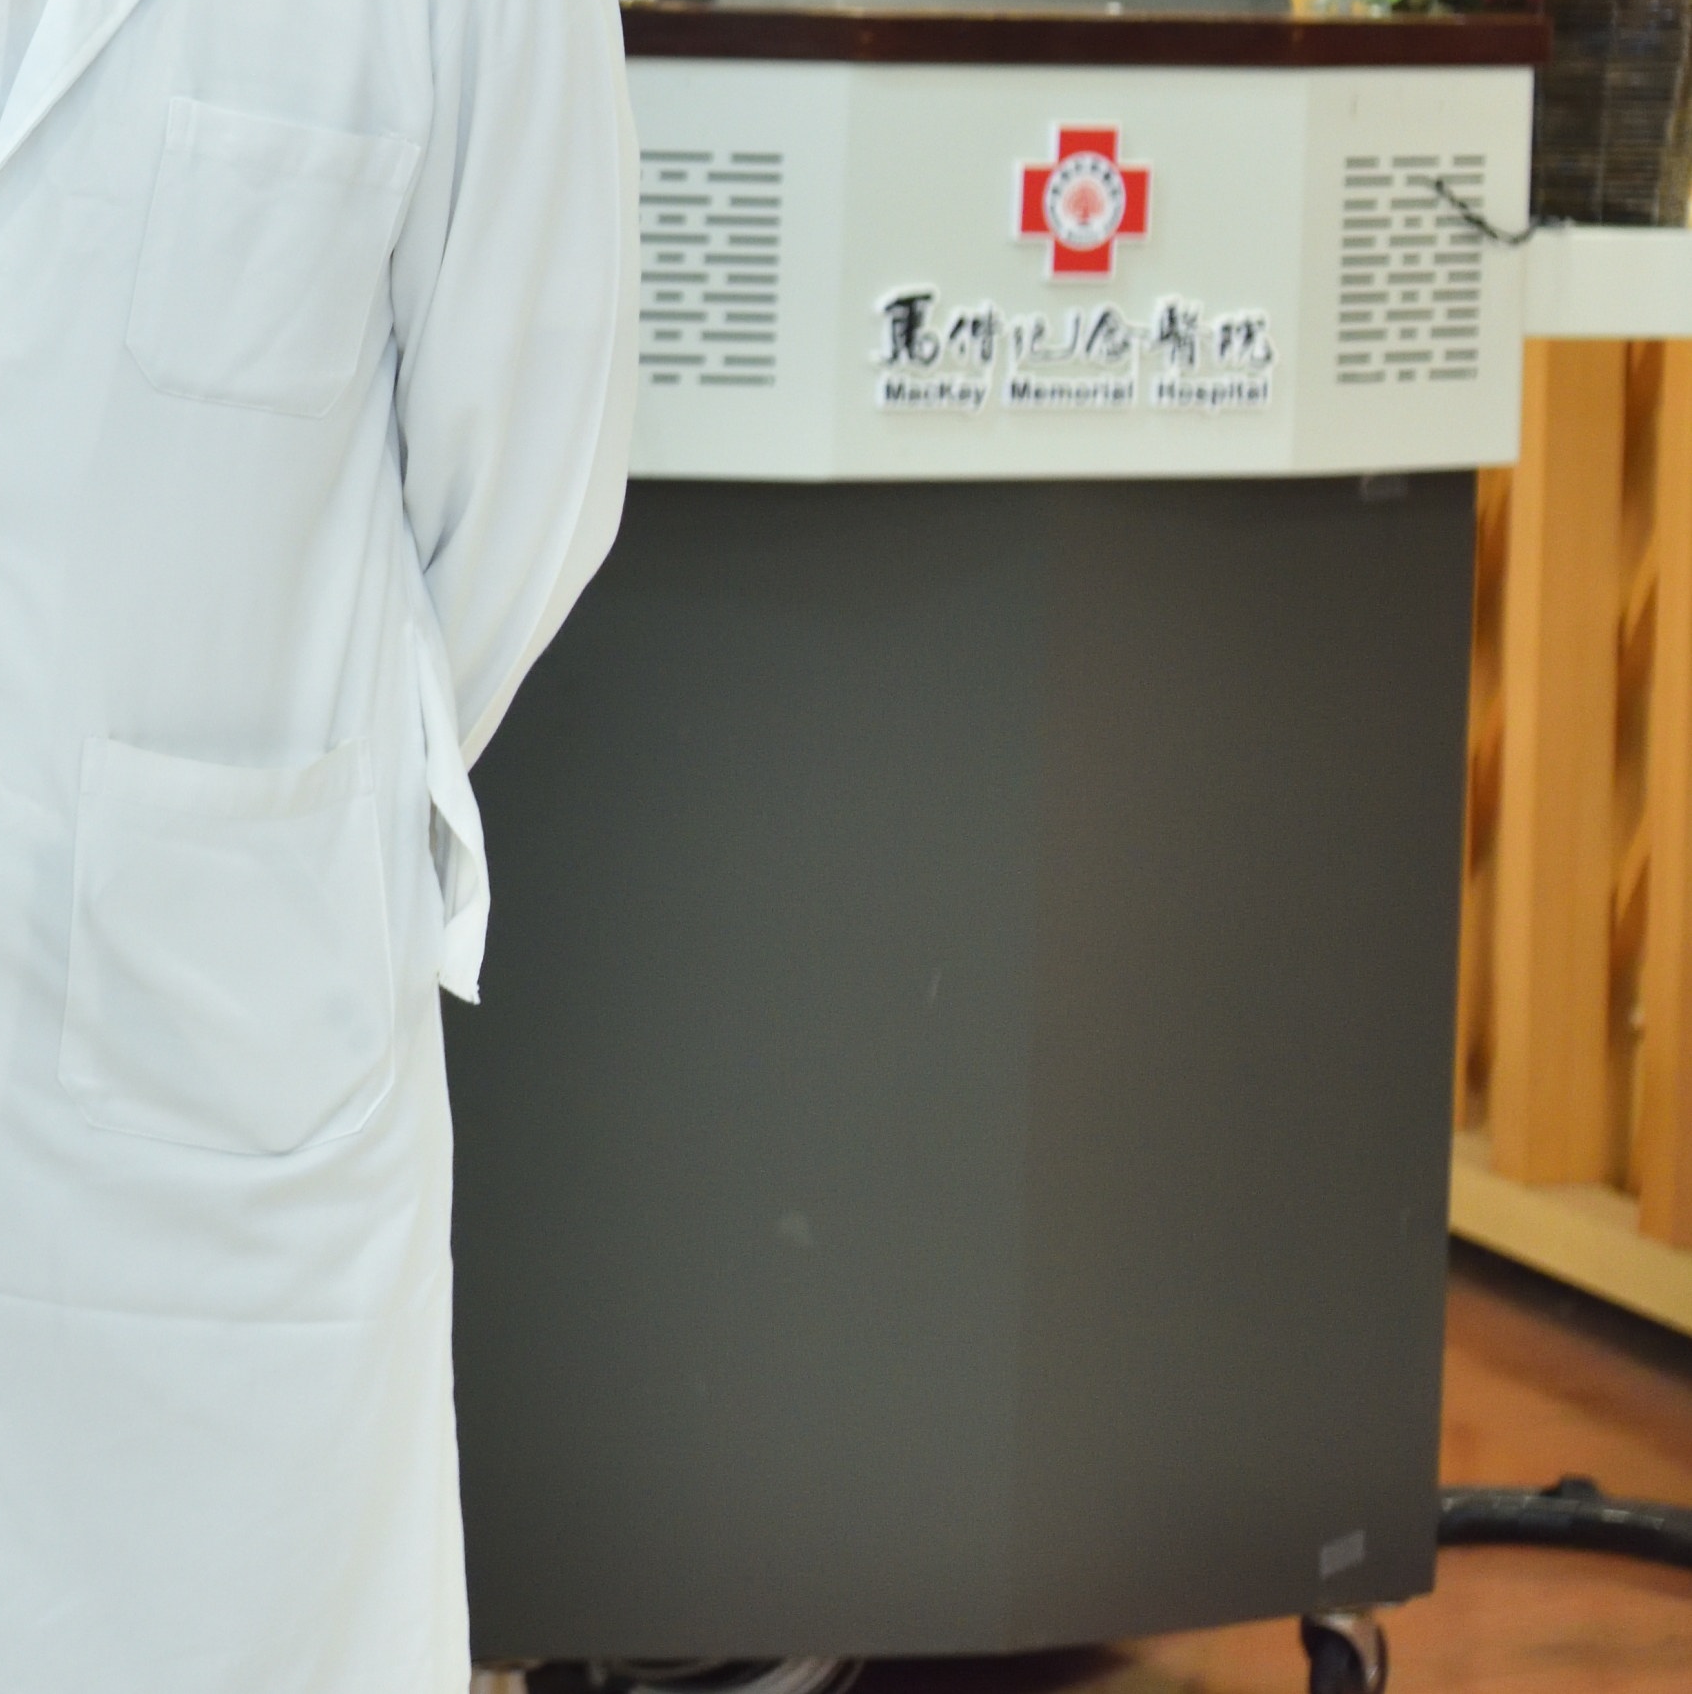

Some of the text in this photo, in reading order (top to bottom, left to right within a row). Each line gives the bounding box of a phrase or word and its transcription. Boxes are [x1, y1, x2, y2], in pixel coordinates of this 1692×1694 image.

[884, 379, 1269, 406] MacKay Memorial Hospital
